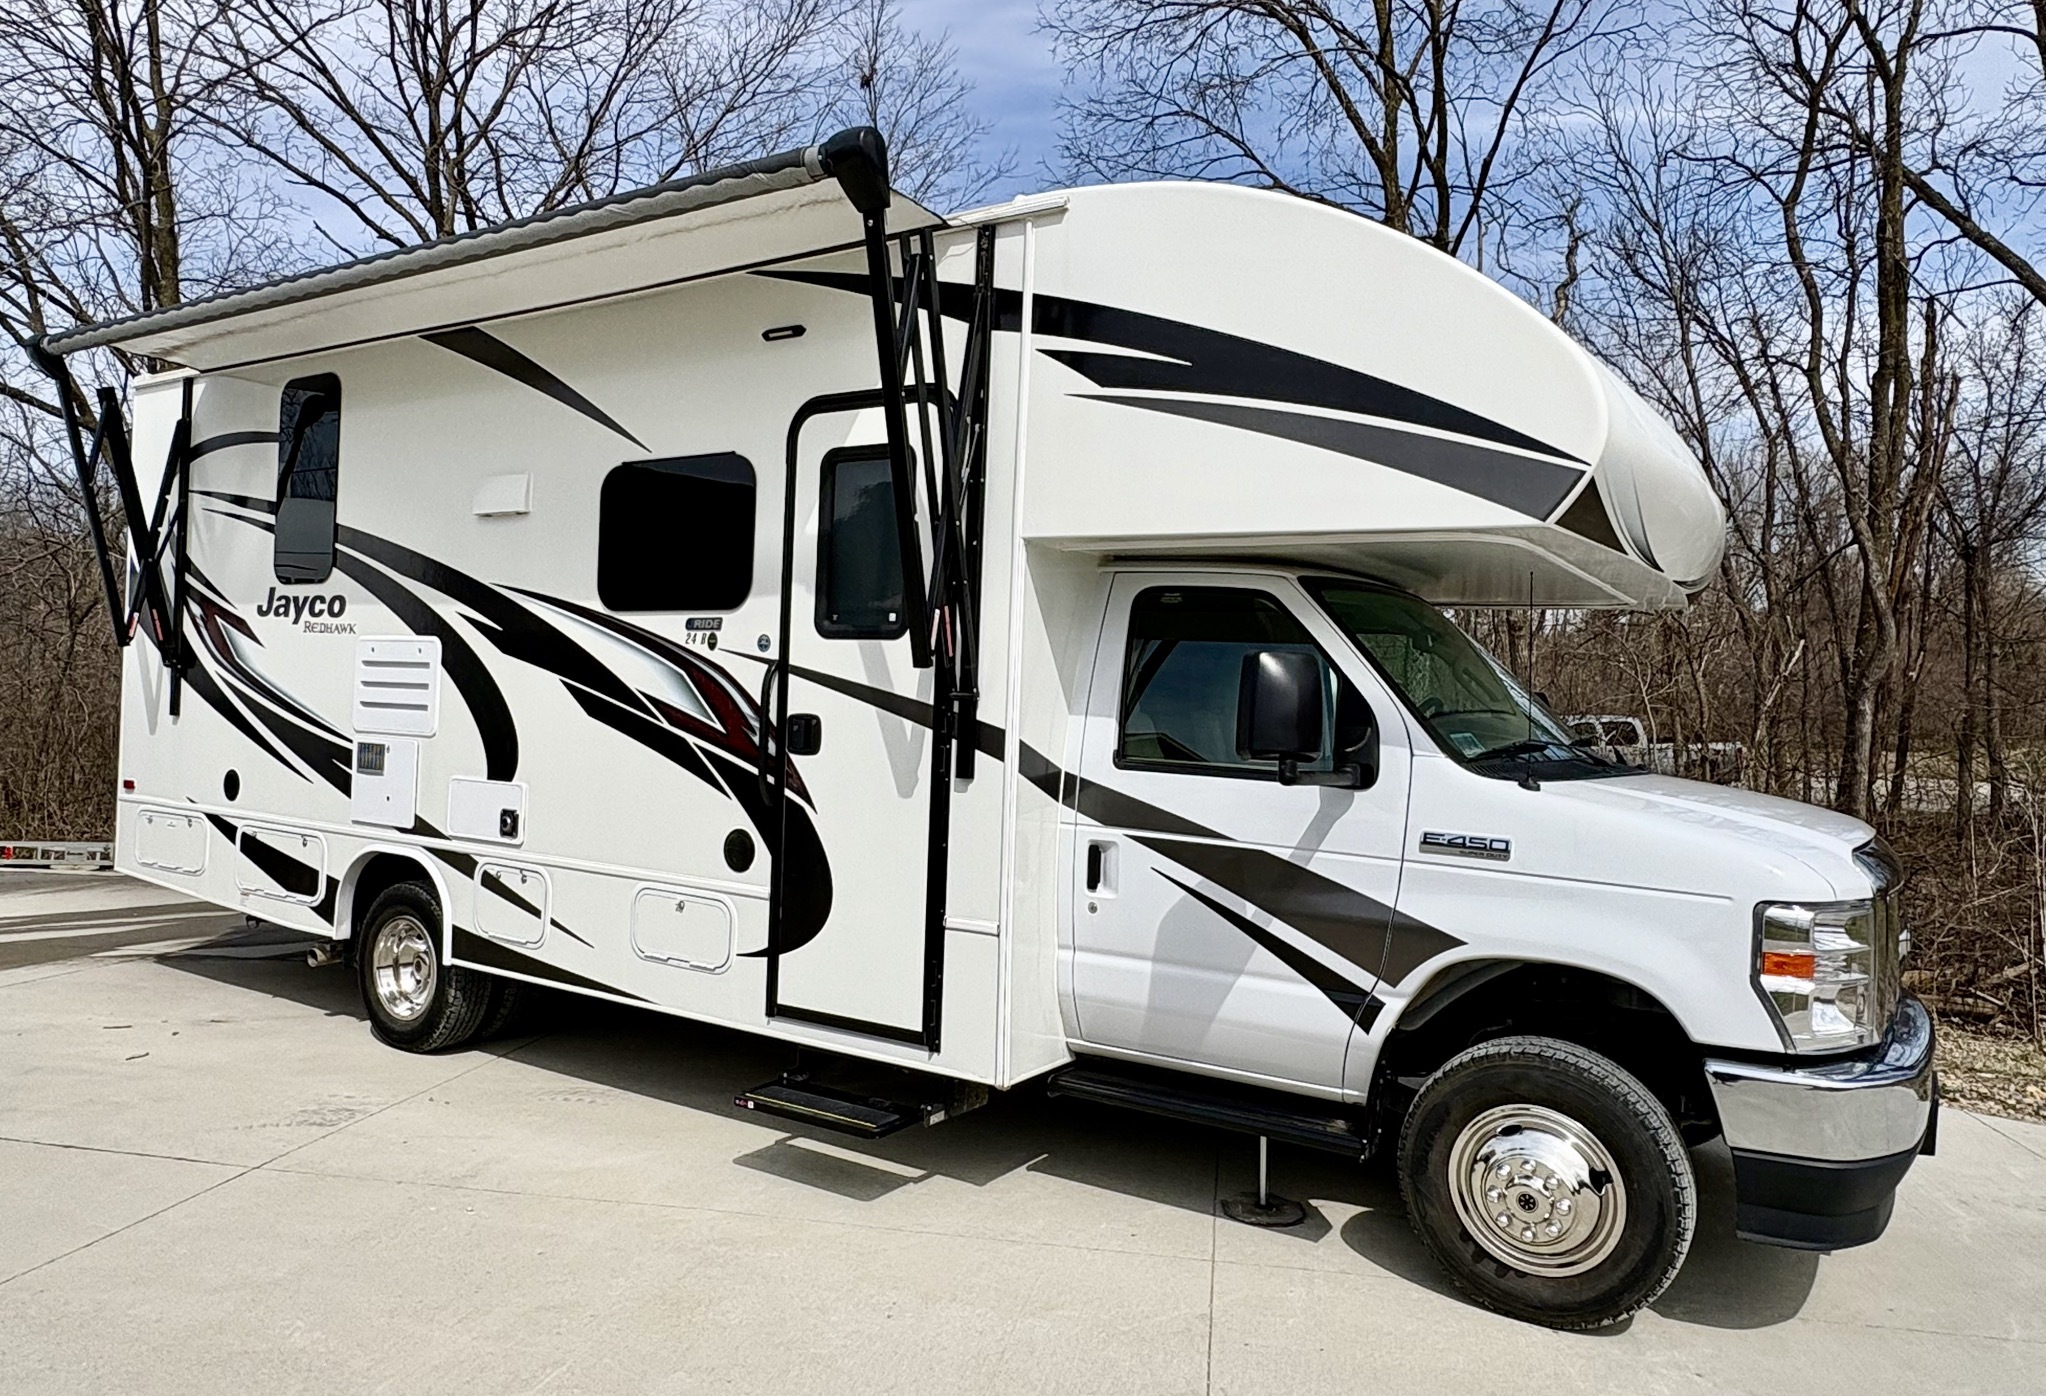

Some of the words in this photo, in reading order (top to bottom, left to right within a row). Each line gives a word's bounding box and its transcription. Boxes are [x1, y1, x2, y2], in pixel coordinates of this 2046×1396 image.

[257, 587, 346, 625] Jayco
[303, 621, 357, 634] REDHAWK
[1422, 832, 1510, 852] E-450
